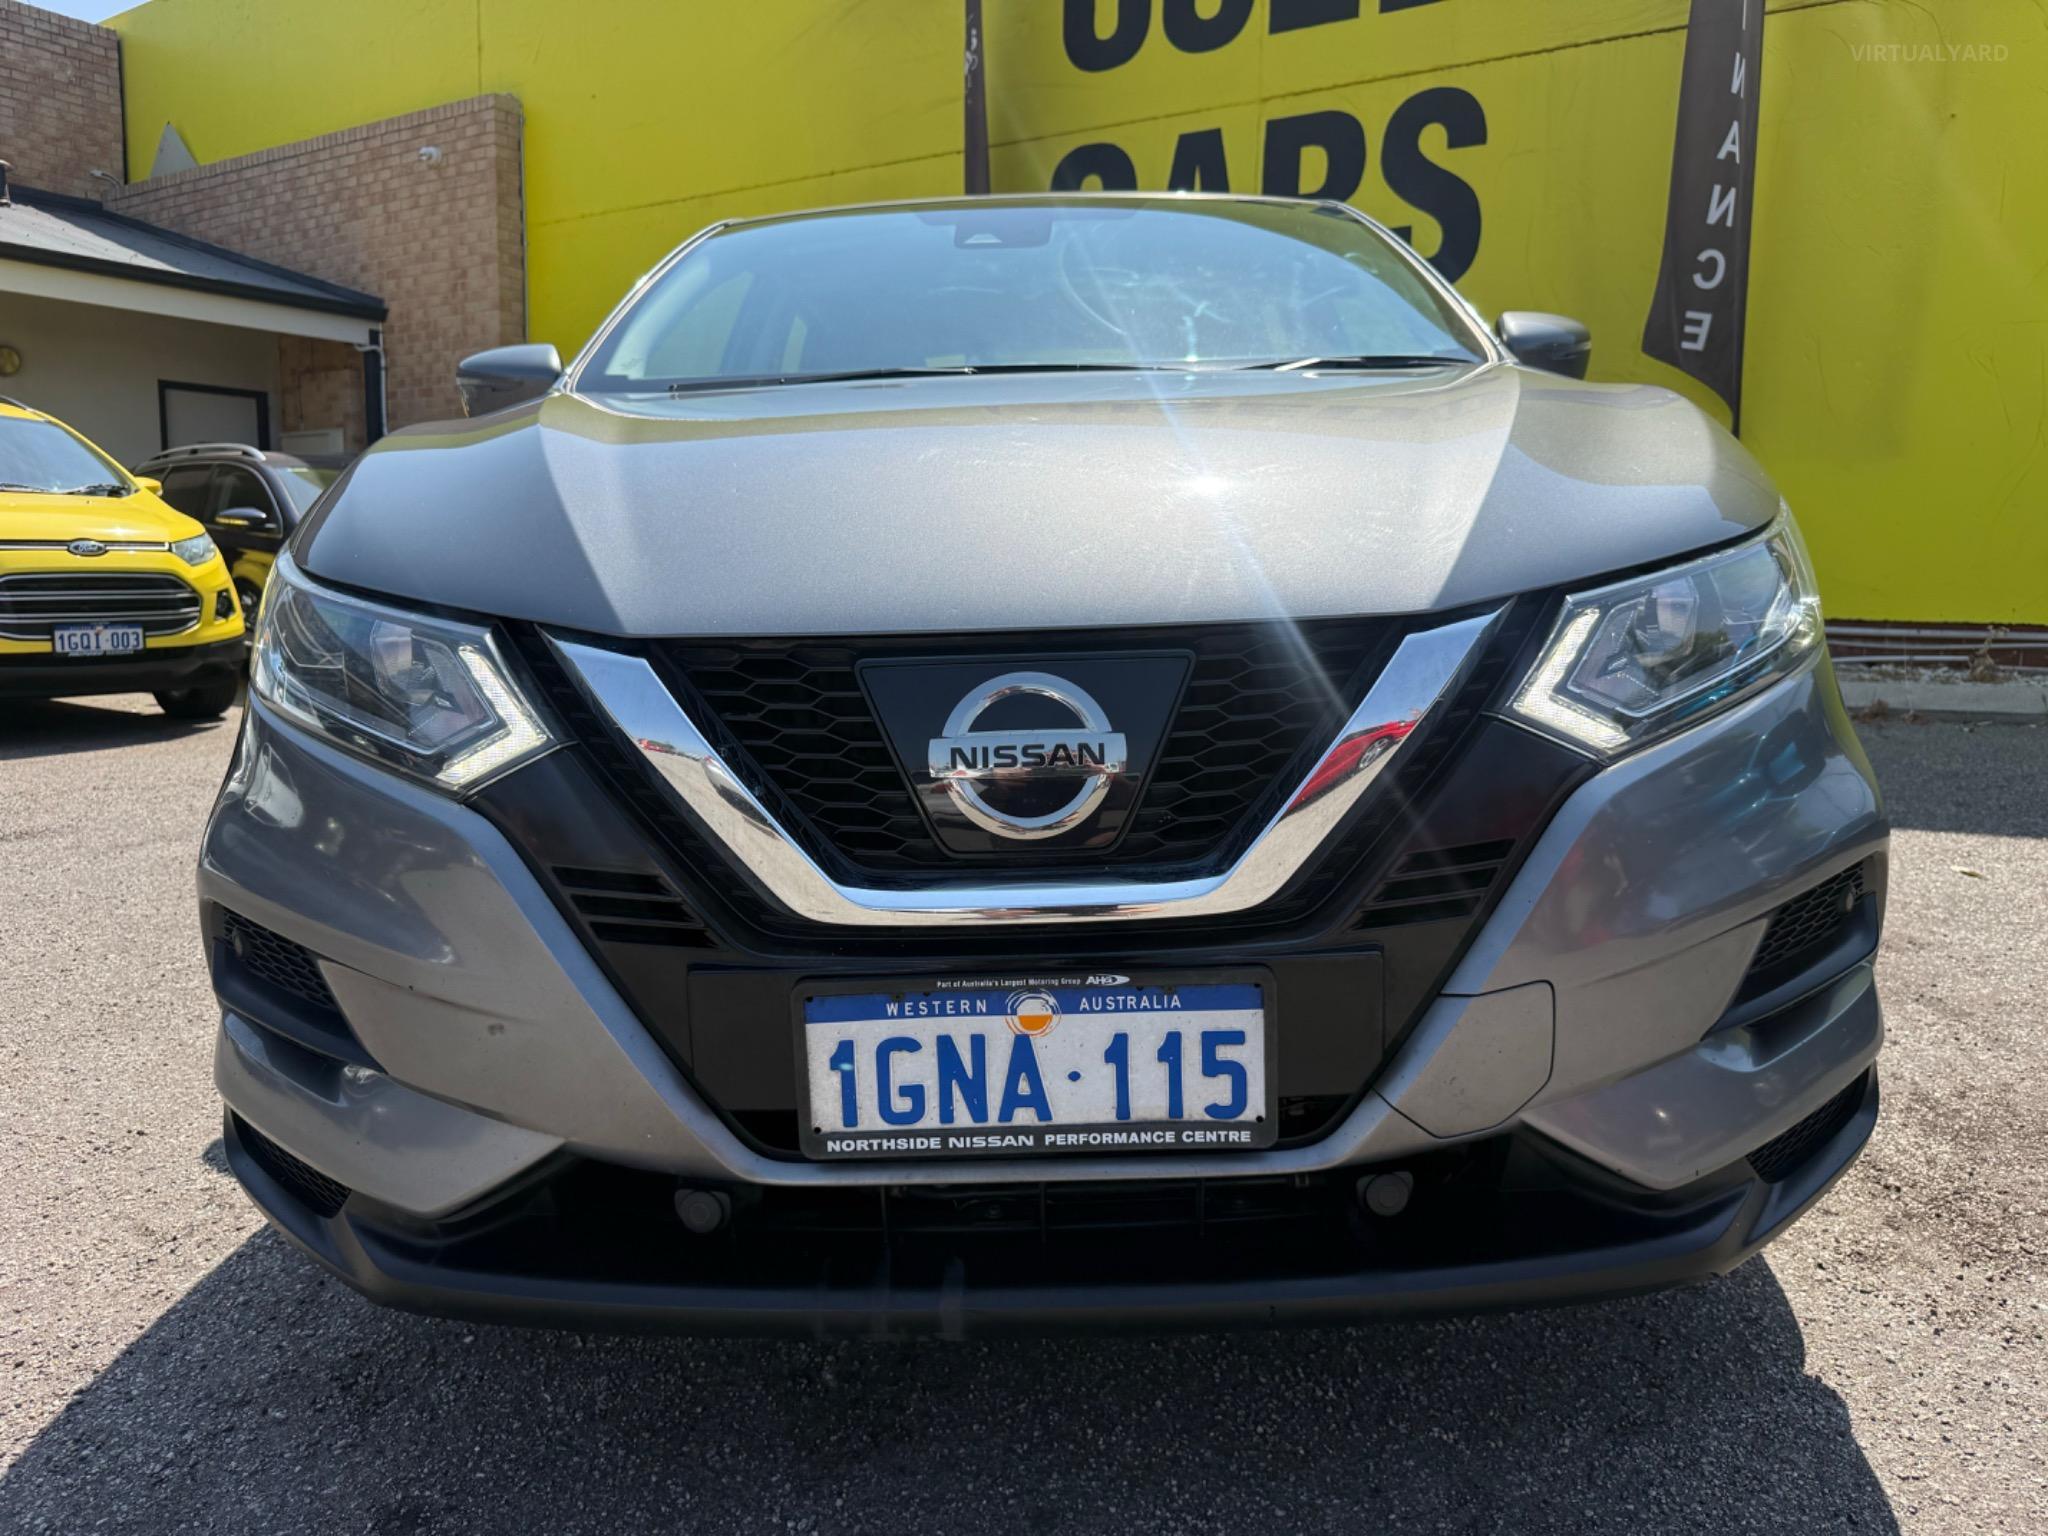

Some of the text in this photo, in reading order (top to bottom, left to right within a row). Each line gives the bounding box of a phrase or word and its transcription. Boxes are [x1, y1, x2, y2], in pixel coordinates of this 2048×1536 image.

[951, 742, 1105, 769] NISSAN
[937, 980, 951, 988] Part
[962, 979, 998, 988] Australia's
[1000, 978, 1026, 987] Largest
[1028, 978, 1058, 988] Motoring
[1061, 978, 1080, 986] Group
[886, 994, 1181, 1017] WESTERN AUSTRALIA
[826, 1130, 1251, 1152] NORTHSIDE NISSAN PERFORMANCE CENTRE
